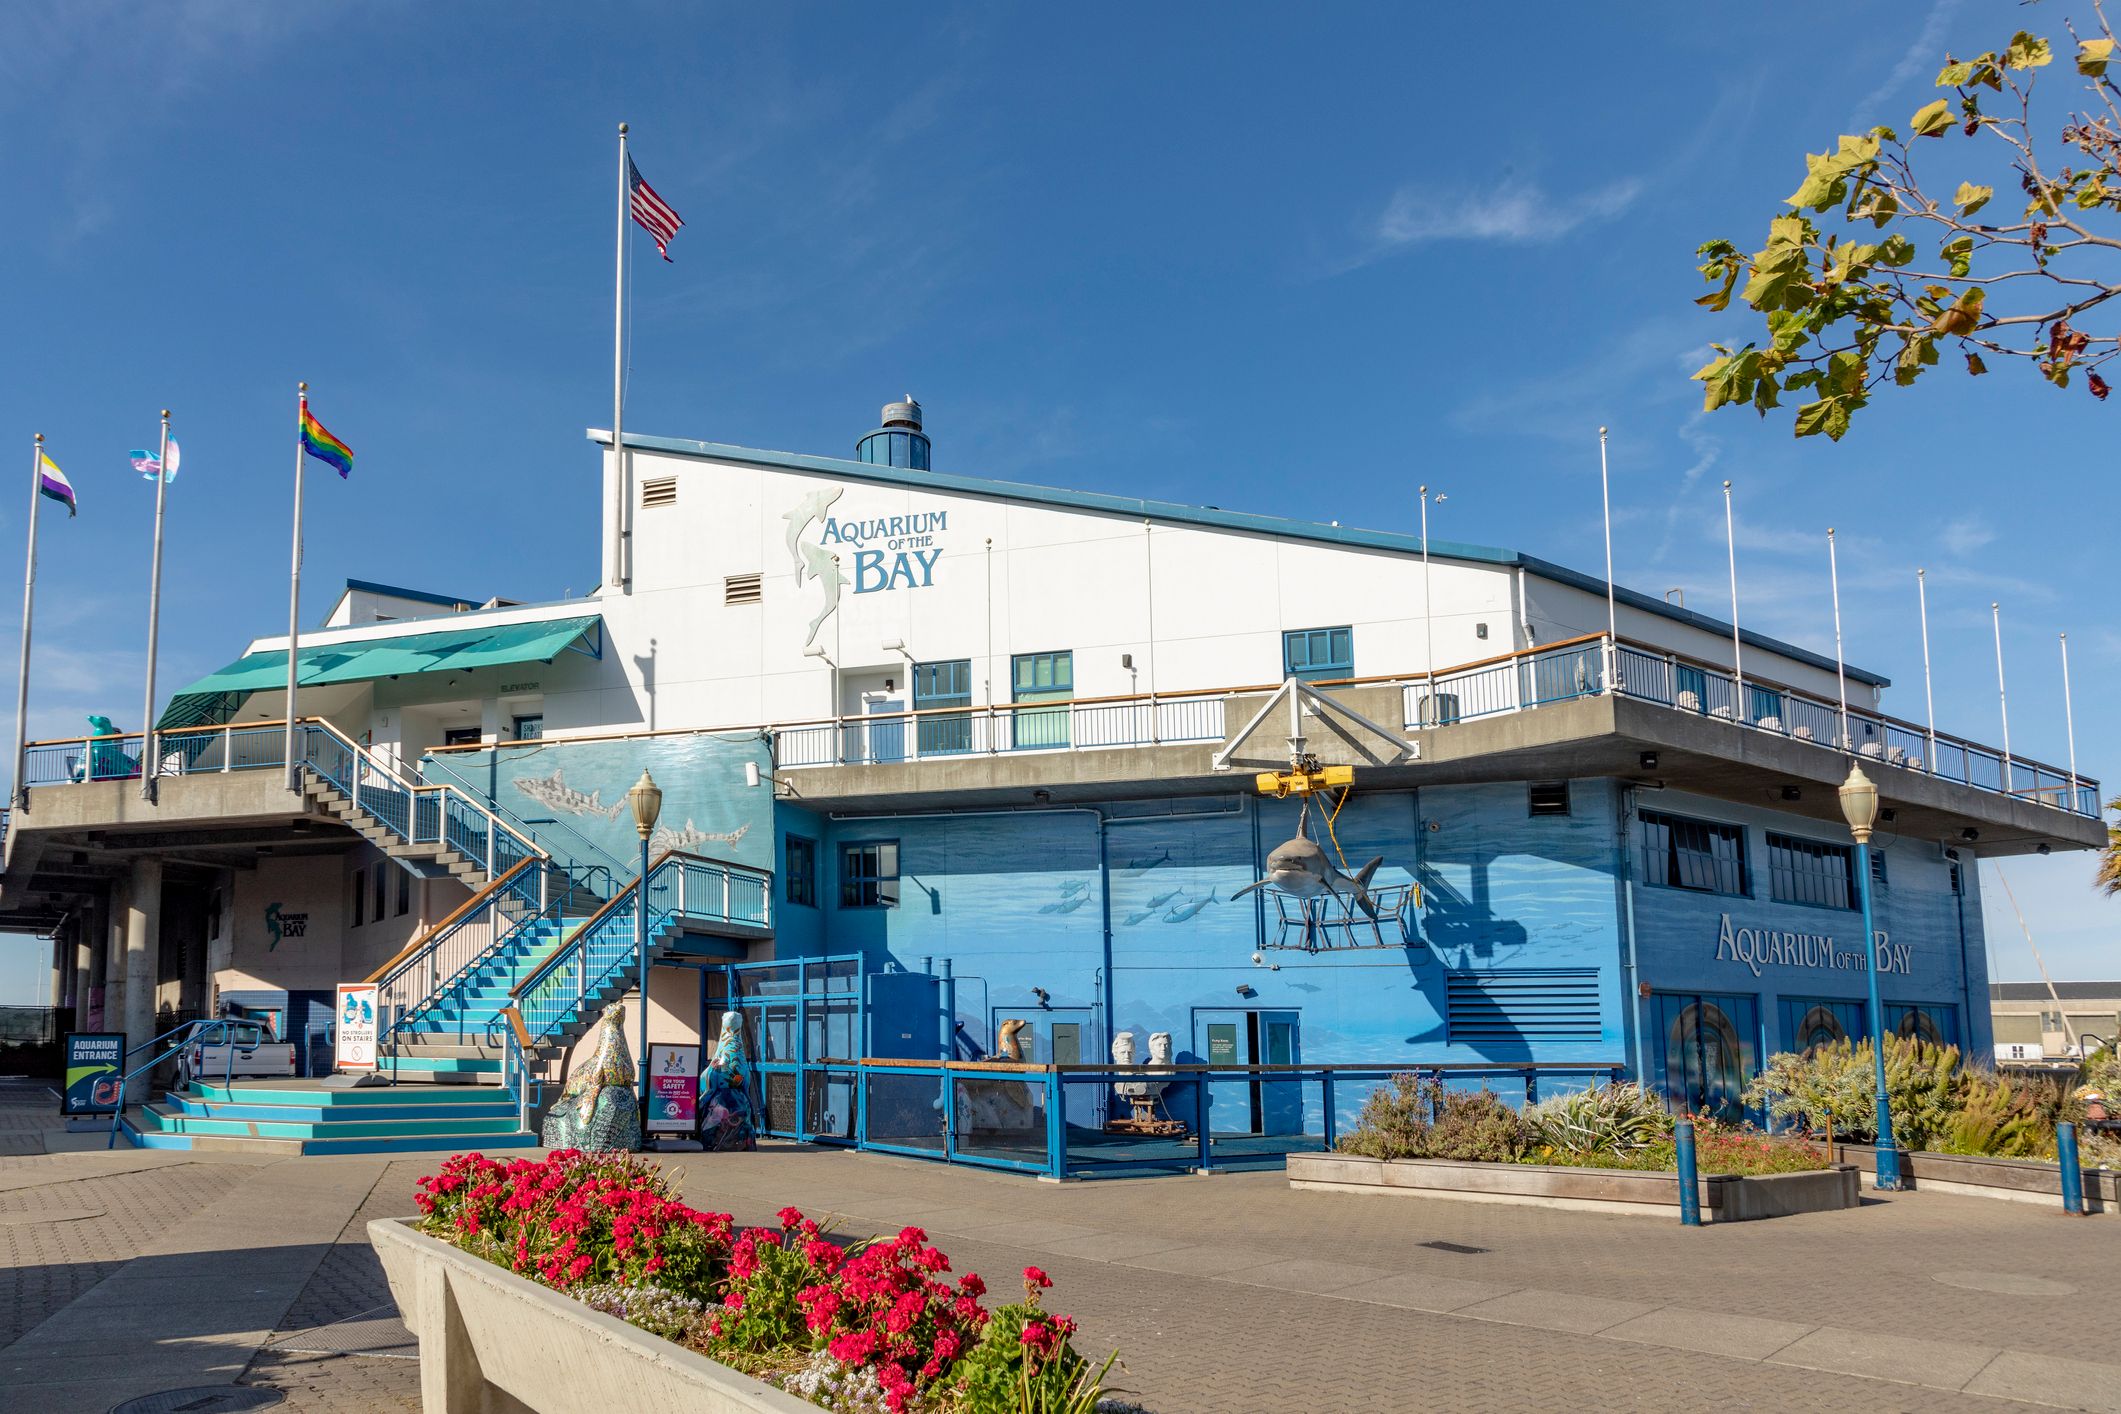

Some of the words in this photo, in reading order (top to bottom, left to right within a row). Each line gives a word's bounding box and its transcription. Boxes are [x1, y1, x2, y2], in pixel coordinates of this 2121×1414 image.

[820, 511, 947, 548] AQUARIUM
[888, 539, 905, 550] OF
[907, 535, 933, 548] THE
[853, 548, 944, 594] BAY
[501, 682, 539, 692] ELEVATOR
[276, 912, 308, 921] AQUARIUM
[283, 923, 307, 937] BAY
[1715, 913, 1835, 977] AQUARIUM
[1836, 952, 1850, 969] OF
[1852, 953, 1867, 970] TH
[1872, 930, 1913, 974] BAY
[73, 1040, 118, 1050] AQUARIUM
[73, 1050, 118, 1060] ENTRANCE
